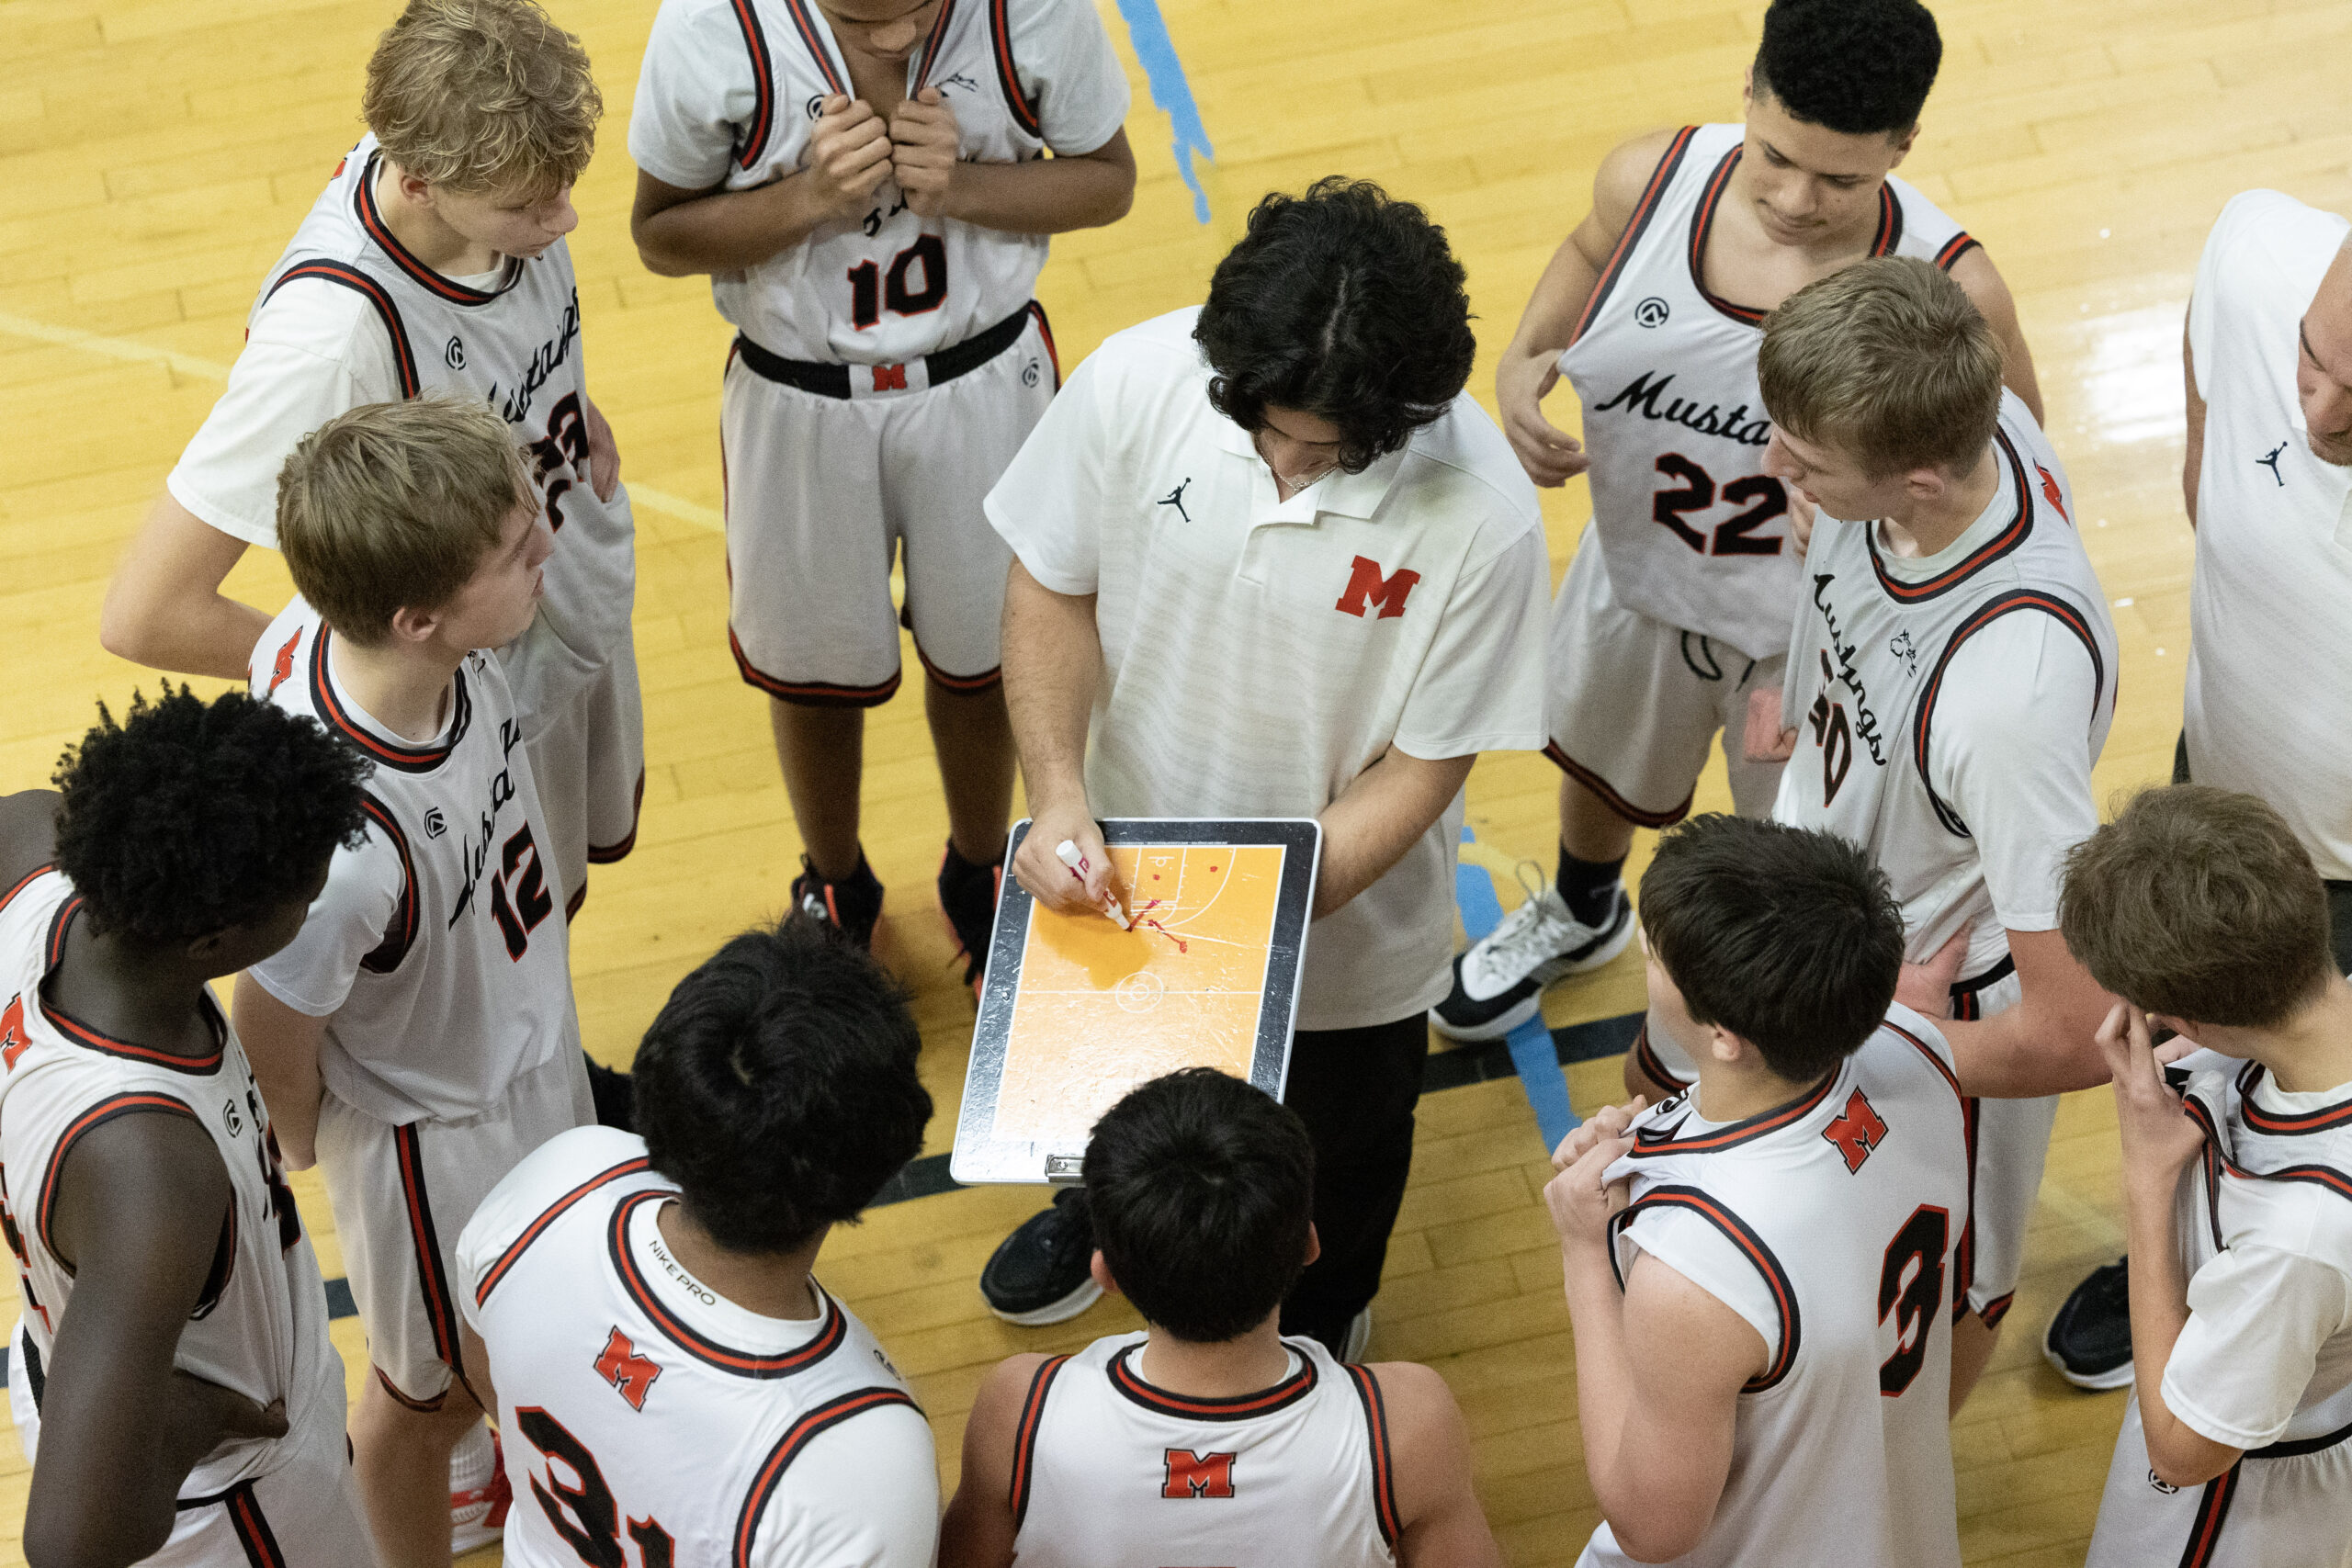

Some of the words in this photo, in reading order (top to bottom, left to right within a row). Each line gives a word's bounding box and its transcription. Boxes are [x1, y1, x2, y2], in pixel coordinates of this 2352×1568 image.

[847, 233, 948, 332] 10
[872, 363, 908, 392] M
[1594, 370, 1771, 446] Musta
[1653, 452, 1789, 556] 22
[1335, 554, 1421, 620] M
[491, 818, 553, 964] 12
[1821, 1082, 1890, 1176] M
[649, 1240, 678, 1277] NIKE
[676, 1274, 716, 1306] PRO
[1877, 1203, 1950, 1398] 3
[593, 1324, 663, 1413] M
[1161, 1448, 1238, 1498] M
